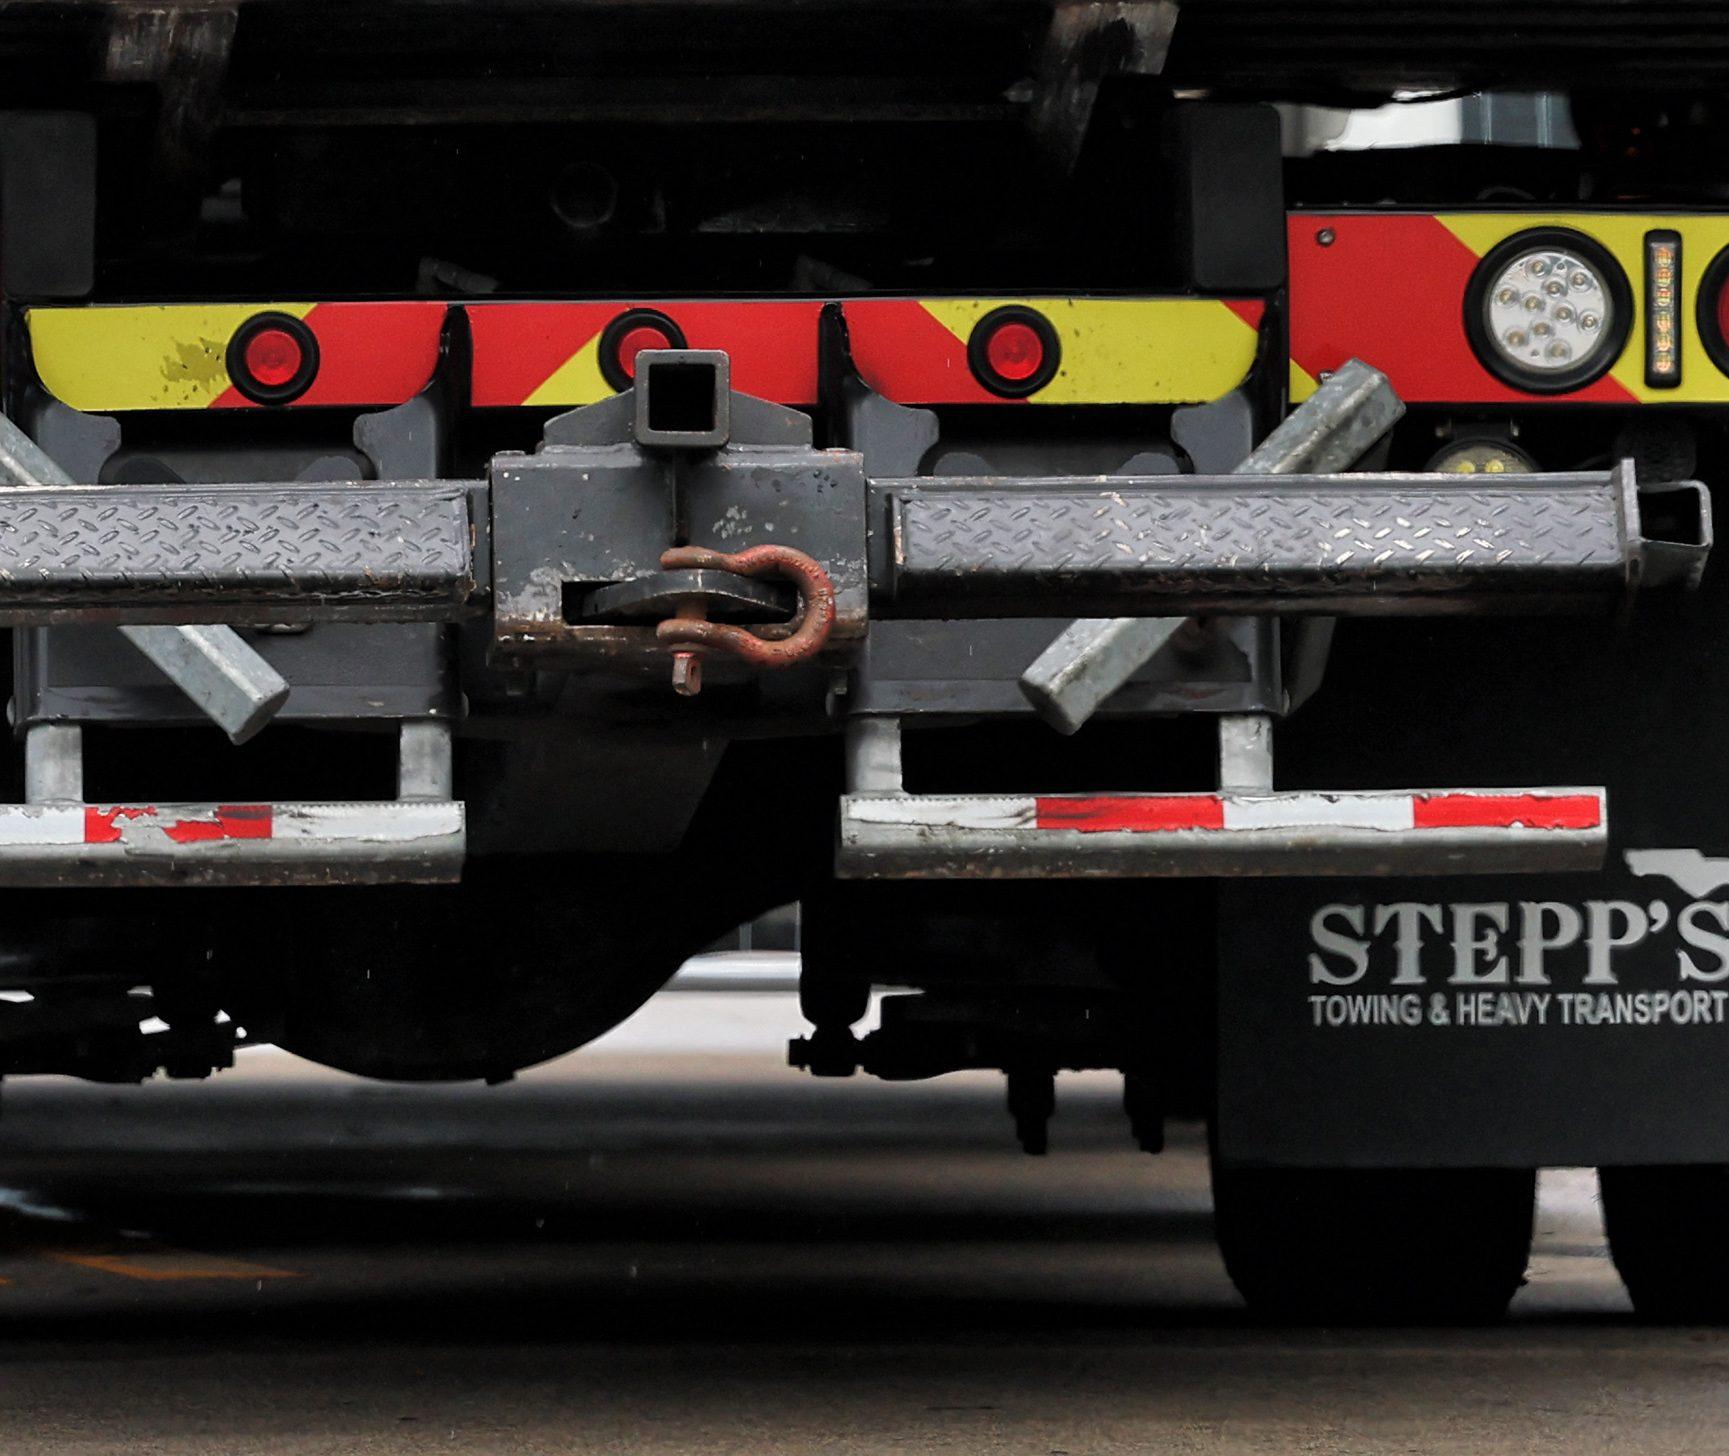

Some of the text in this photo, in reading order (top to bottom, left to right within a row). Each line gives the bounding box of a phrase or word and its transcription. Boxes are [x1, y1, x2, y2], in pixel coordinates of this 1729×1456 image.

[1308, 990, 1729, 1026] TOWING & HEAVY TRANSPORT
